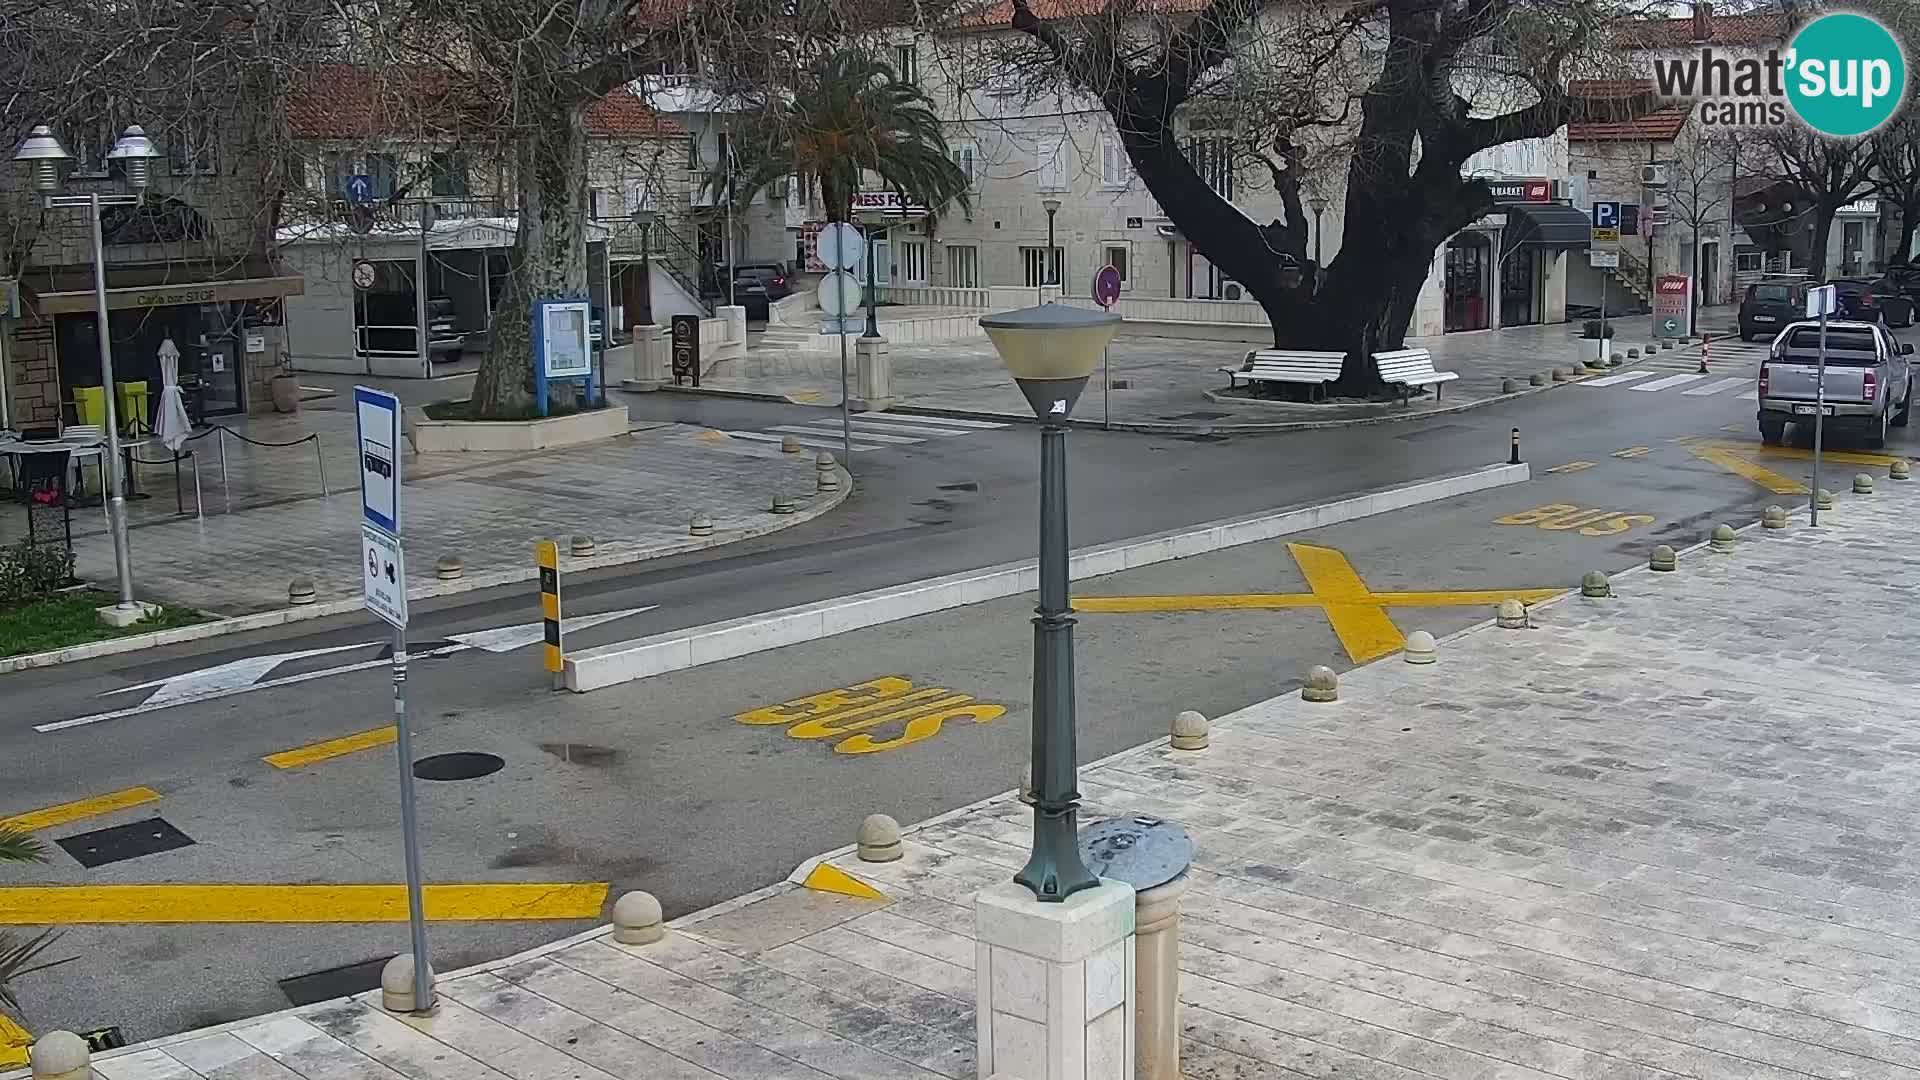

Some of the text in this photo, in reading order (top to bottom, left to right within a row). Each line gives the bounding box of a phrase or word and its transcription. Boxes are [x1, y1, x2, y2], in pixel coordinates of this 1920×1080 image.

[888, 194, 915, 206] FOO
[1488, 186, 1525, 196] RMARKET
[1597, 203, 1613, 226] P
[1492, 503, 1656, 537] BUS
[732, 675, 1007, 755] BUS
